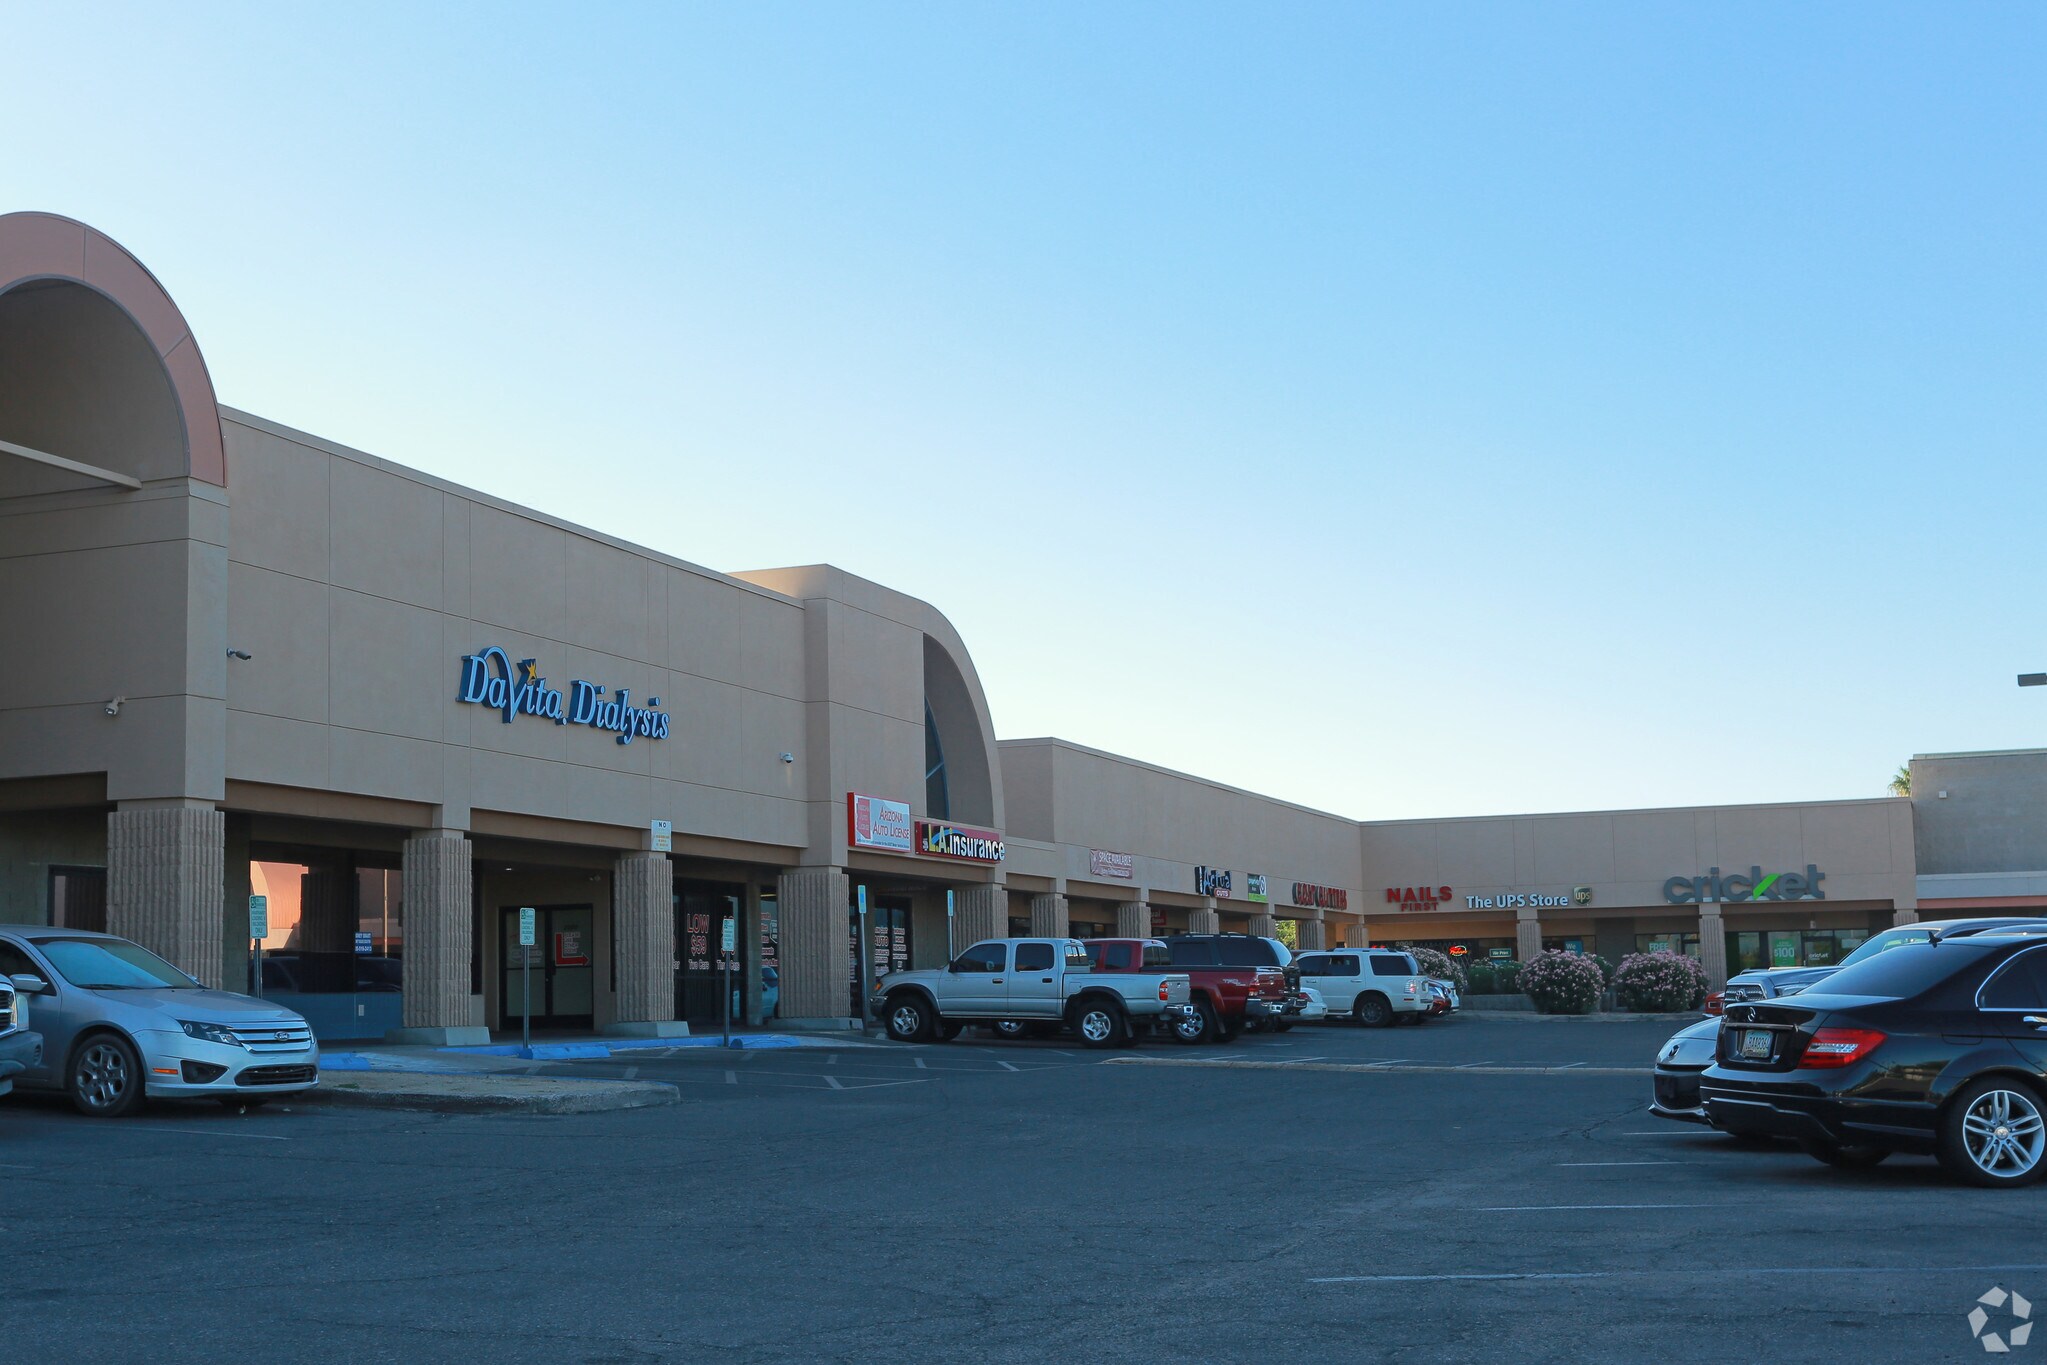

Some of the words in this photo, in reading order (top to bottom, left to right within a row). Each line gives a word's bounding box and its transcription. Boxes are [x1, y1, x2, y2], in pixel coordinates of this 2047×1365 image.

[571, 679, 670, 745] Dialysis
[879, 806, 903, 823] ARIZONA
[873, 820, 889, 836] AUTO
[890, 823, 910, 839] LICENSE
[1663, 864, 1826, 904] cricket
[1216, 889, 1229, 898] CUTS
[1386, 885, 1453, 903] NAILS
[1466, 895, 1492, 909] The
[1496, 894, 1526, 908] UPS
[1529, 893, 1569, 907] Store
[1575, 892, 1591, 903] ups
[1401, 902, 1439, 911] FIRST
[687, 913, 710, 934] LOW
[1649, 942, 1669, 951] FREE
[1773, 946, 1795, 959] $100
